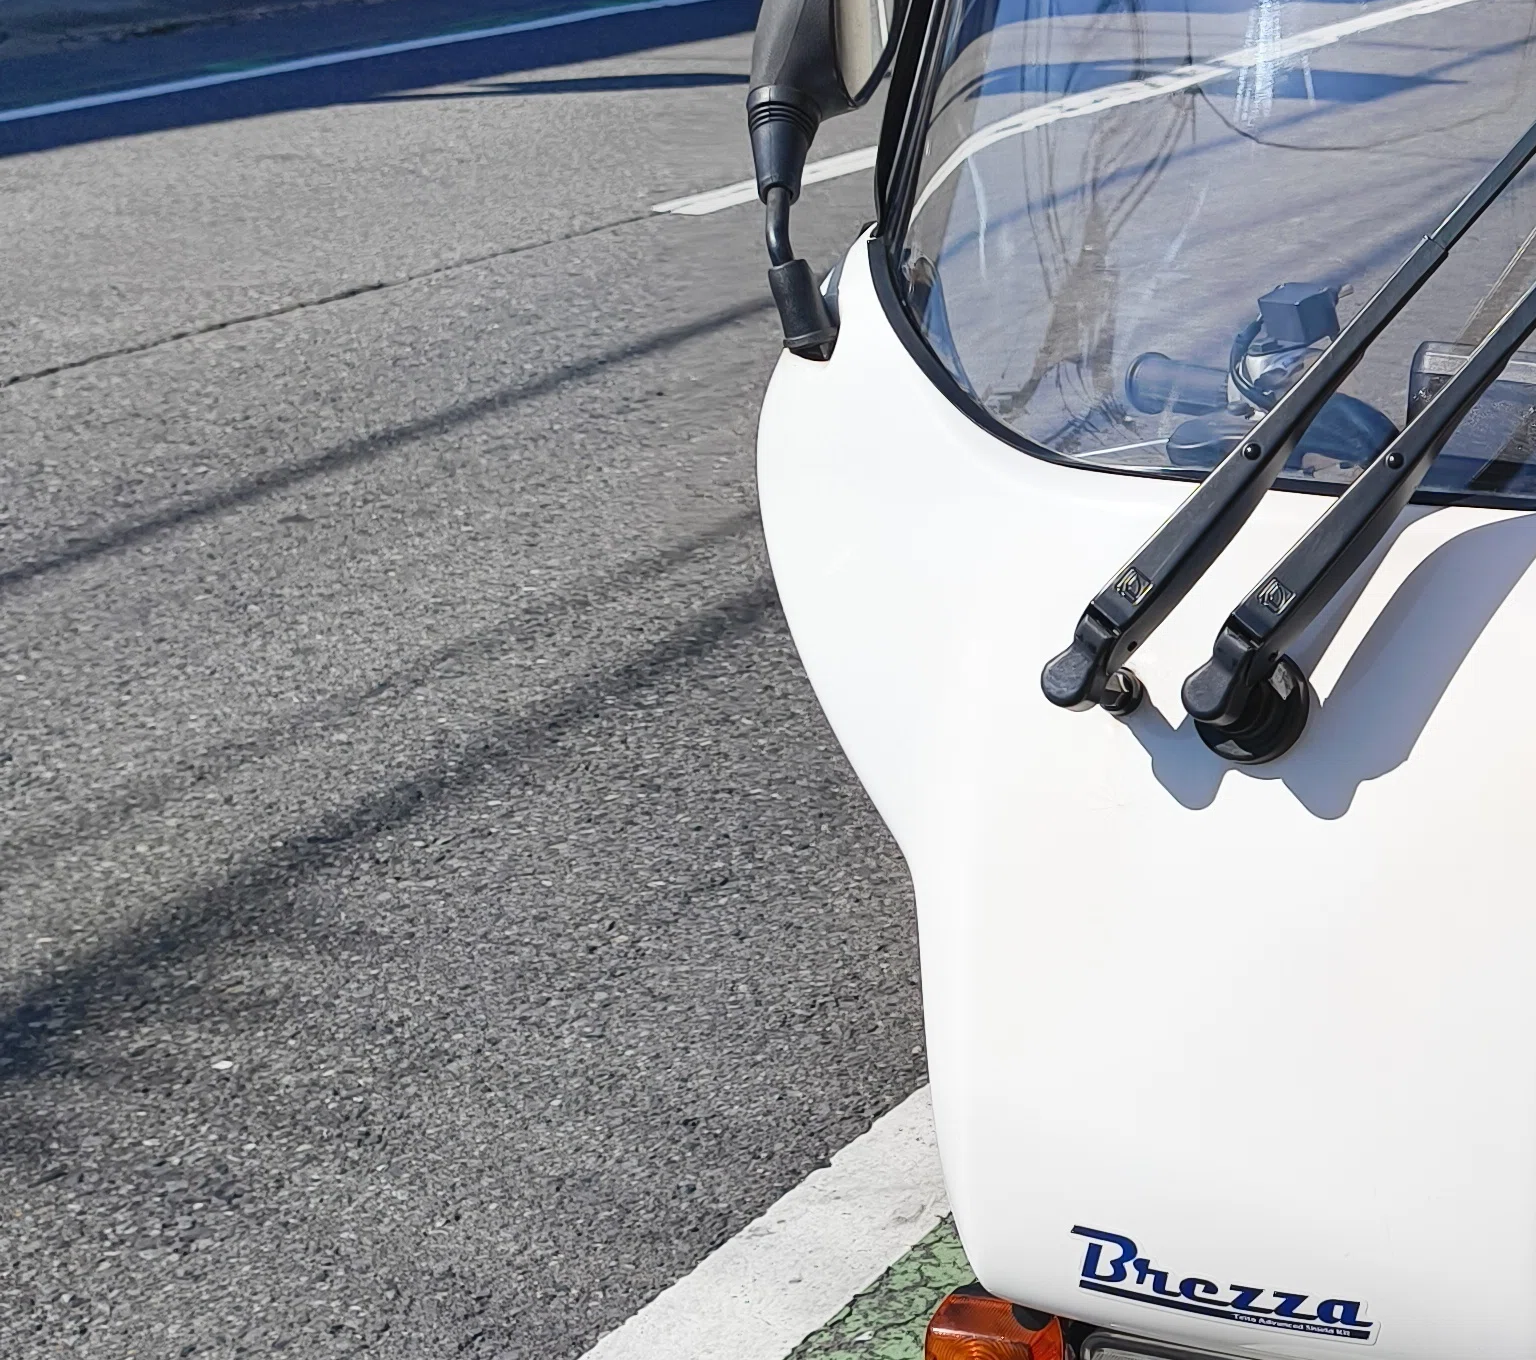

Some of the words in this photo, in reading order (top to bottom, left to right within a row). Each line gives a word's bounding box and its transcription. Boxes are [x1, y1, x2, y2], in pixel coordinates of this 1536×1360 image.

[1071, 1225, 1374, 1328] Brezza
[1258, 1318, 1304, 1331] Advanced
[1305, 1324, 1335, 1336] Shield
[1336, 1328, 1351, 1337] Kit
